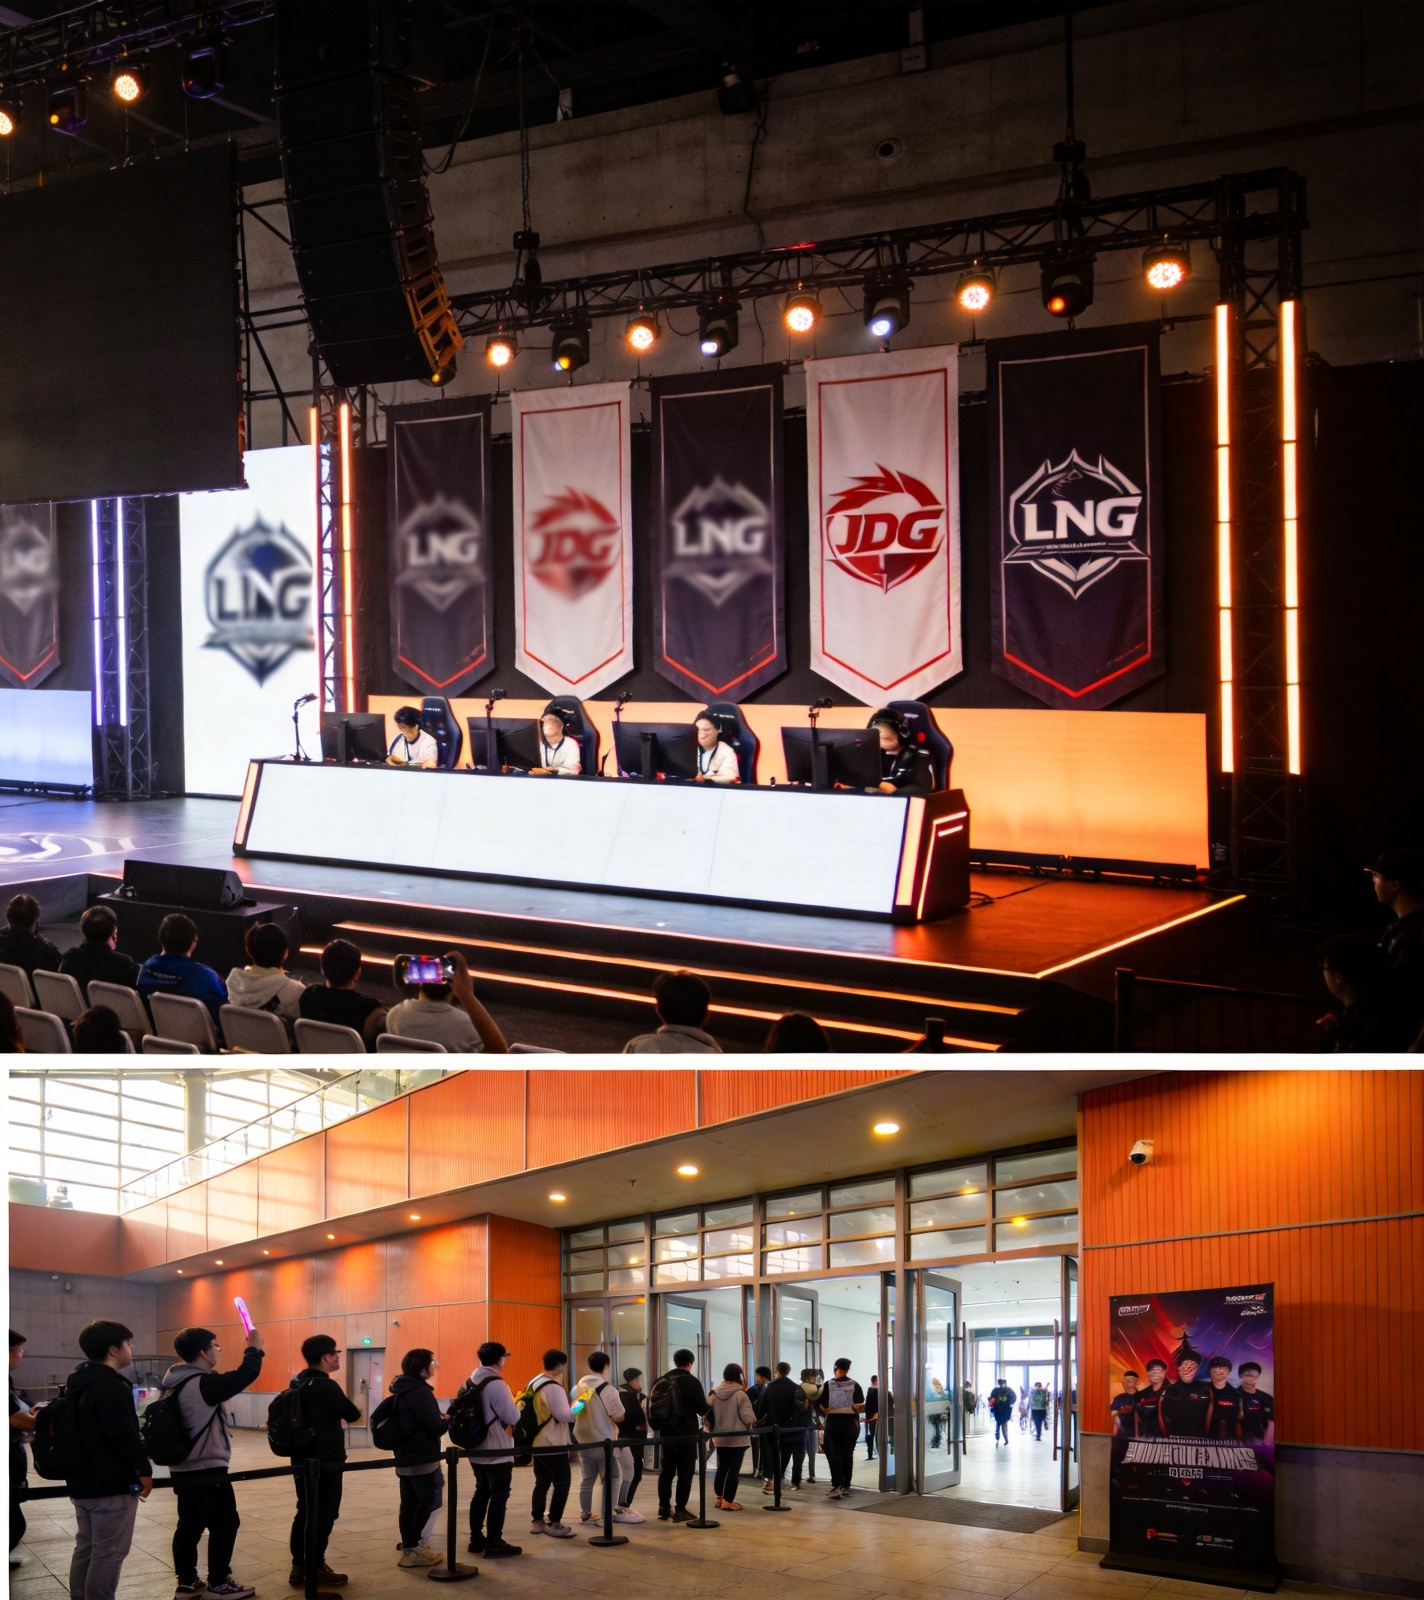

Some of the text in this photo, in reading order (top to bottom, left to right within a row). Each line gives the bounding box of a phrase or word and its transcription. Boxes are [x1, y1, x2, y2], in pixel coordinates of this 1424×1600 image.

[672, 515, 769, 555] LNG
[835, 508, 945, 553] JDG
[1020, 496, 1143, 541] LNG
[407, 530, 479, 566] LNG
[532, 527, 621, 568] JDG
[215, 568, 314, 621] LNG
